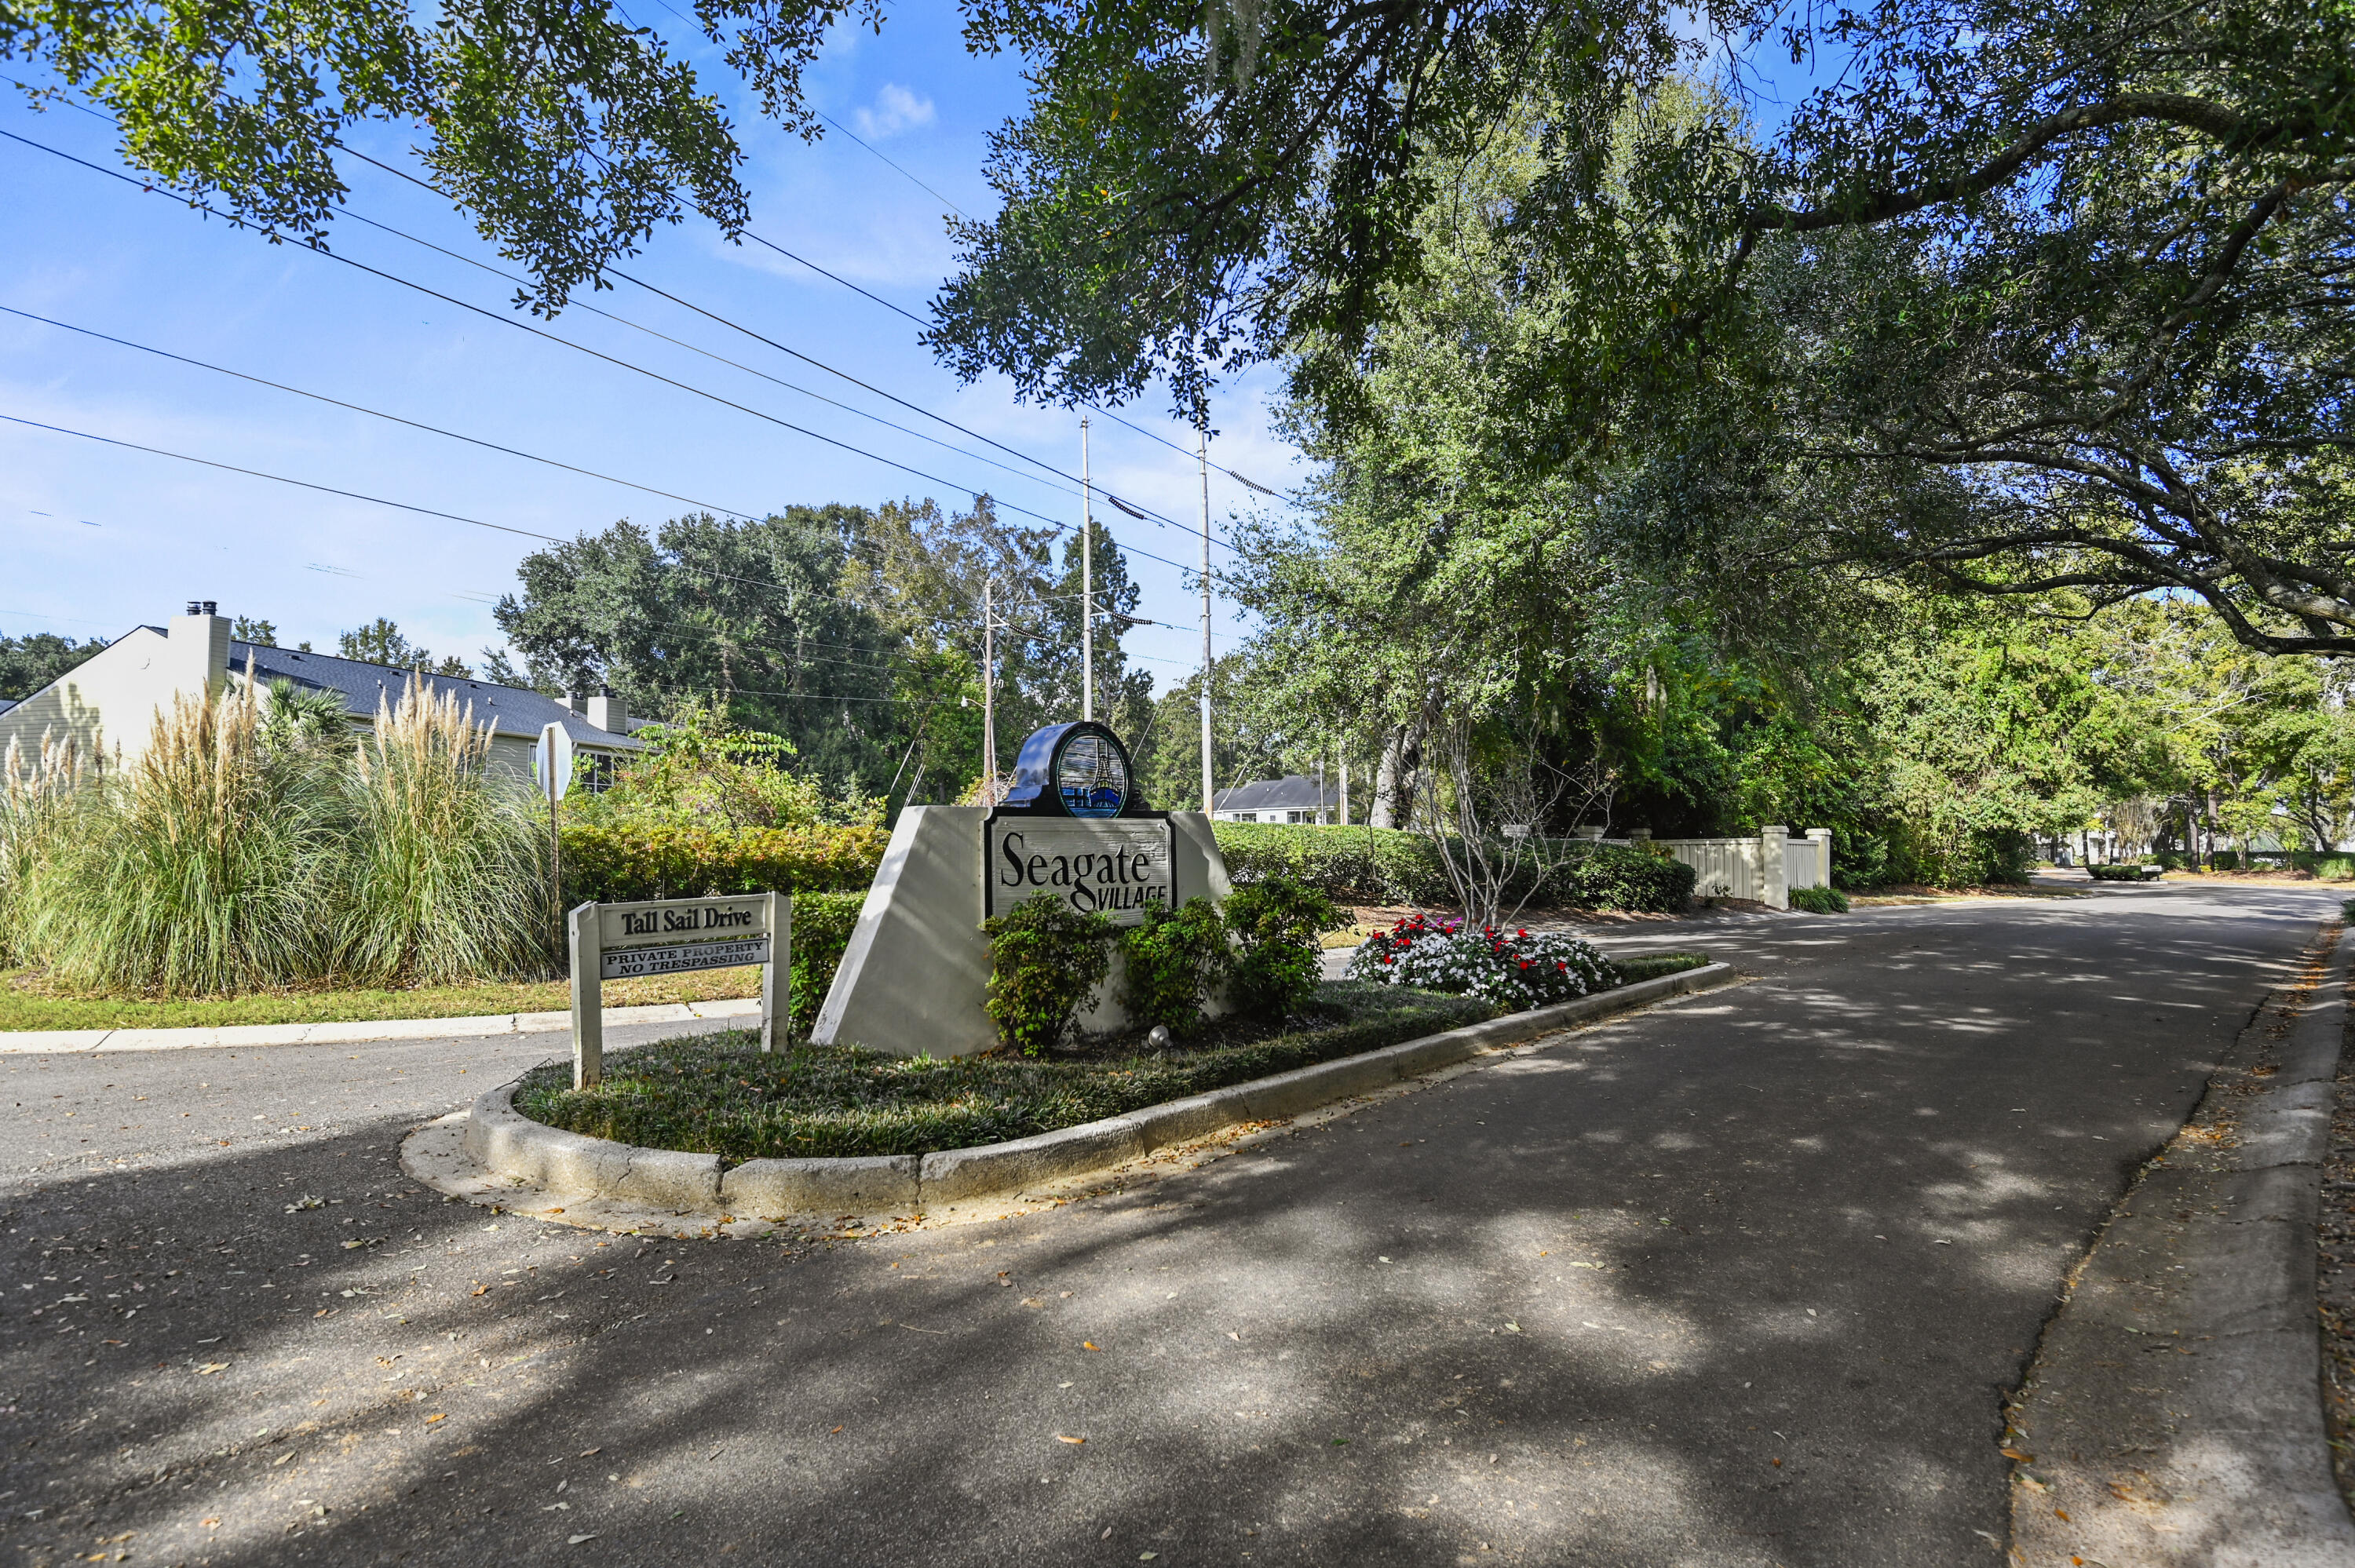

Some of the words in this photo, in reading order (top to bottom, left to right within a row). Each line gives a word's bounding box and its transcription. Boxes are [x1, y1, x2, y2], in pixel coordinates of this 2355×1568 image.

[1001, 832, 1150, 913] Seagate
[621, 910, 658, 935] Tall
[663, 908, 699, 932] Sail
[703, 906, 751, 929] Drive
[607, 950, 677, 965] PRIVATE
[682, 942, 763, 957] PROPERTY
[619, 964, 644, 975] NO
[649, 952, 754, 972] TRESPASSING
